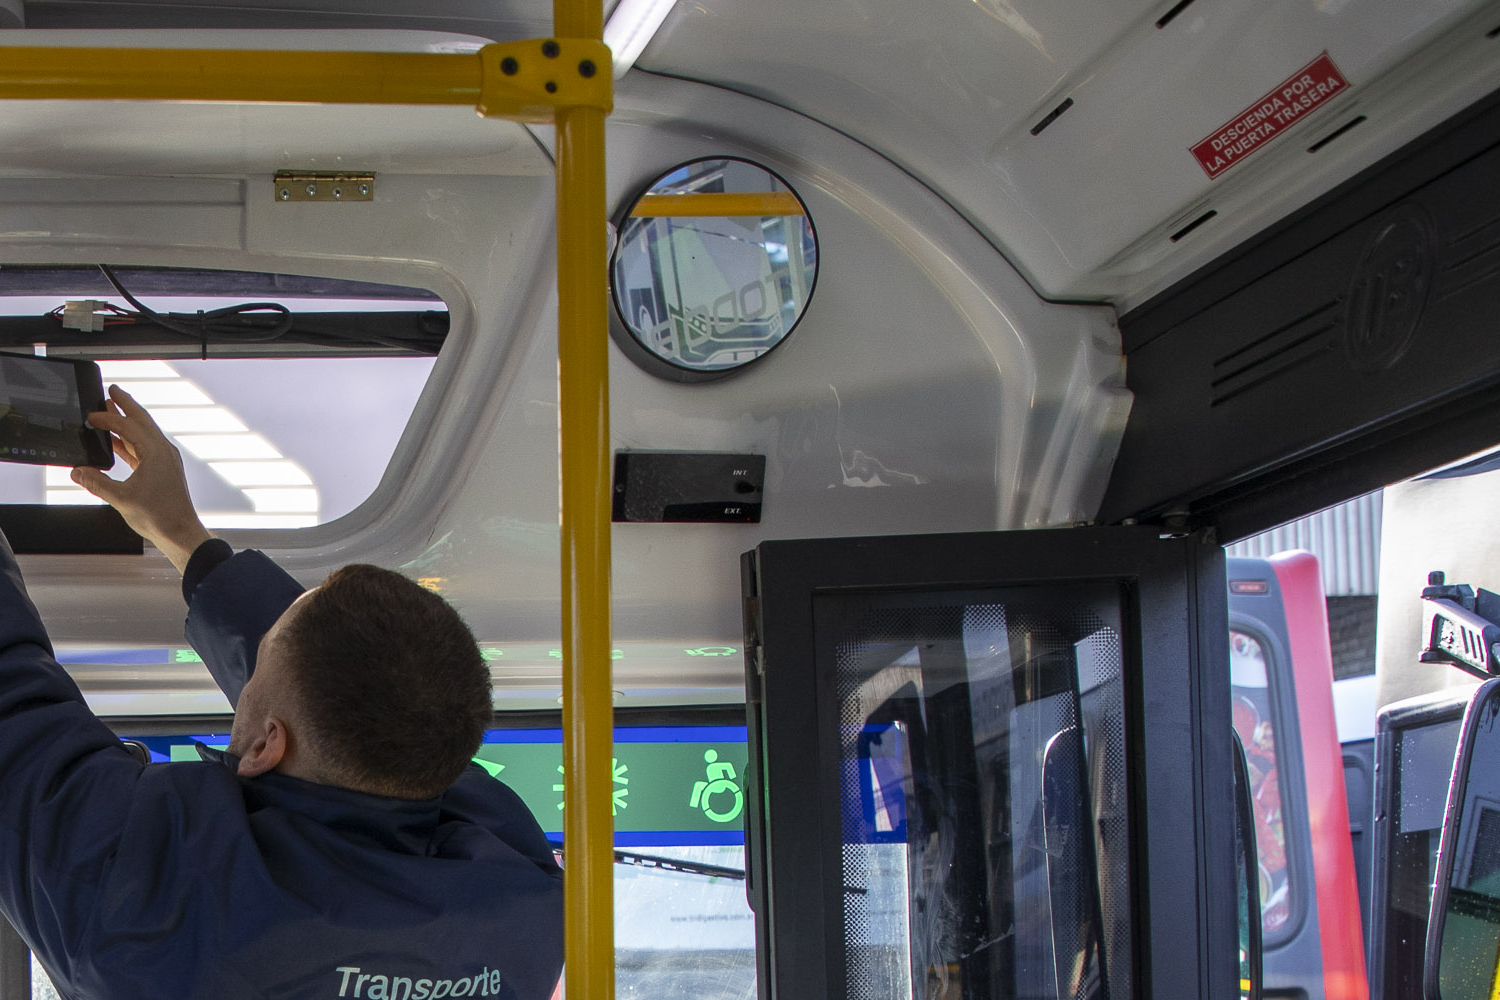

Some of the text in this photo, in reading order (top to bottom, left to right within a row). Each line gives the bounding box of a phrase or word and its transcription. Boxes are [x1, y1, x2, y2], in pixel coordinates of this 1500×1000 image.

[1206, 77, 1340, 172] LA PUERTA TRASERA
[1211, 74, 1315, 151] DESCIENDA POR
